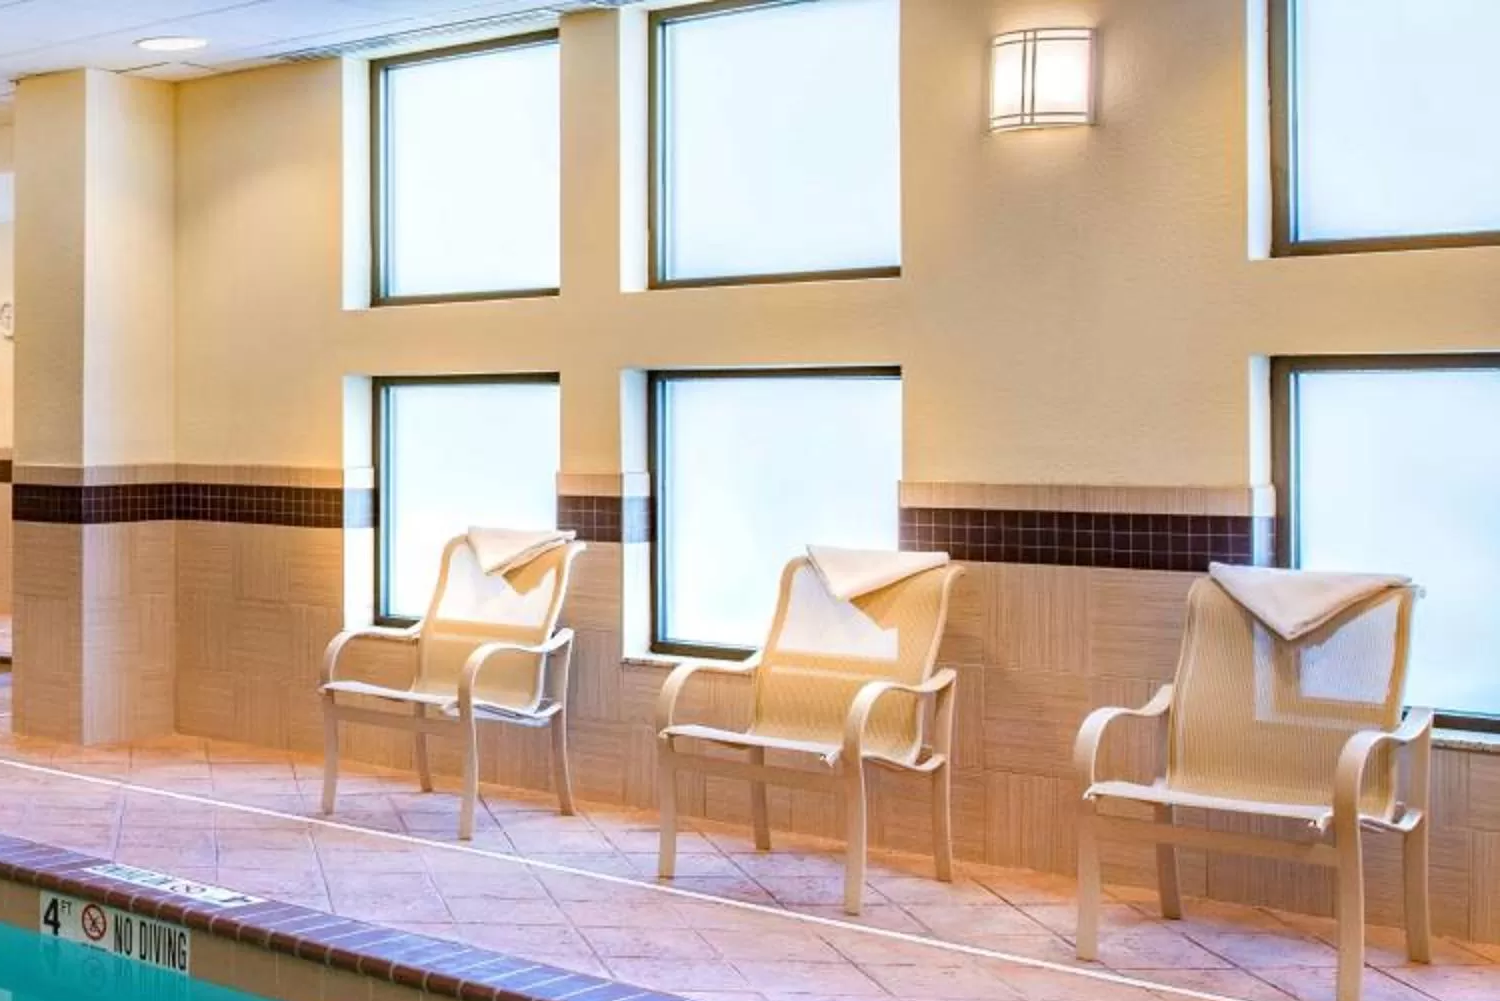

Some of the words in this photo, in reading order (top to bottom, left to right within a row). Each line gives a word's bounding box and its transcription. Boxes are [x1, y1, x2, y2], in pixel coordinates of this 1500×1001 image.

[44, 898, 61, 936] 4
[61, 900, 72, 916] FT
[114, 915, 132, 955] NO
[140, 921, 186, 970] DIVING
